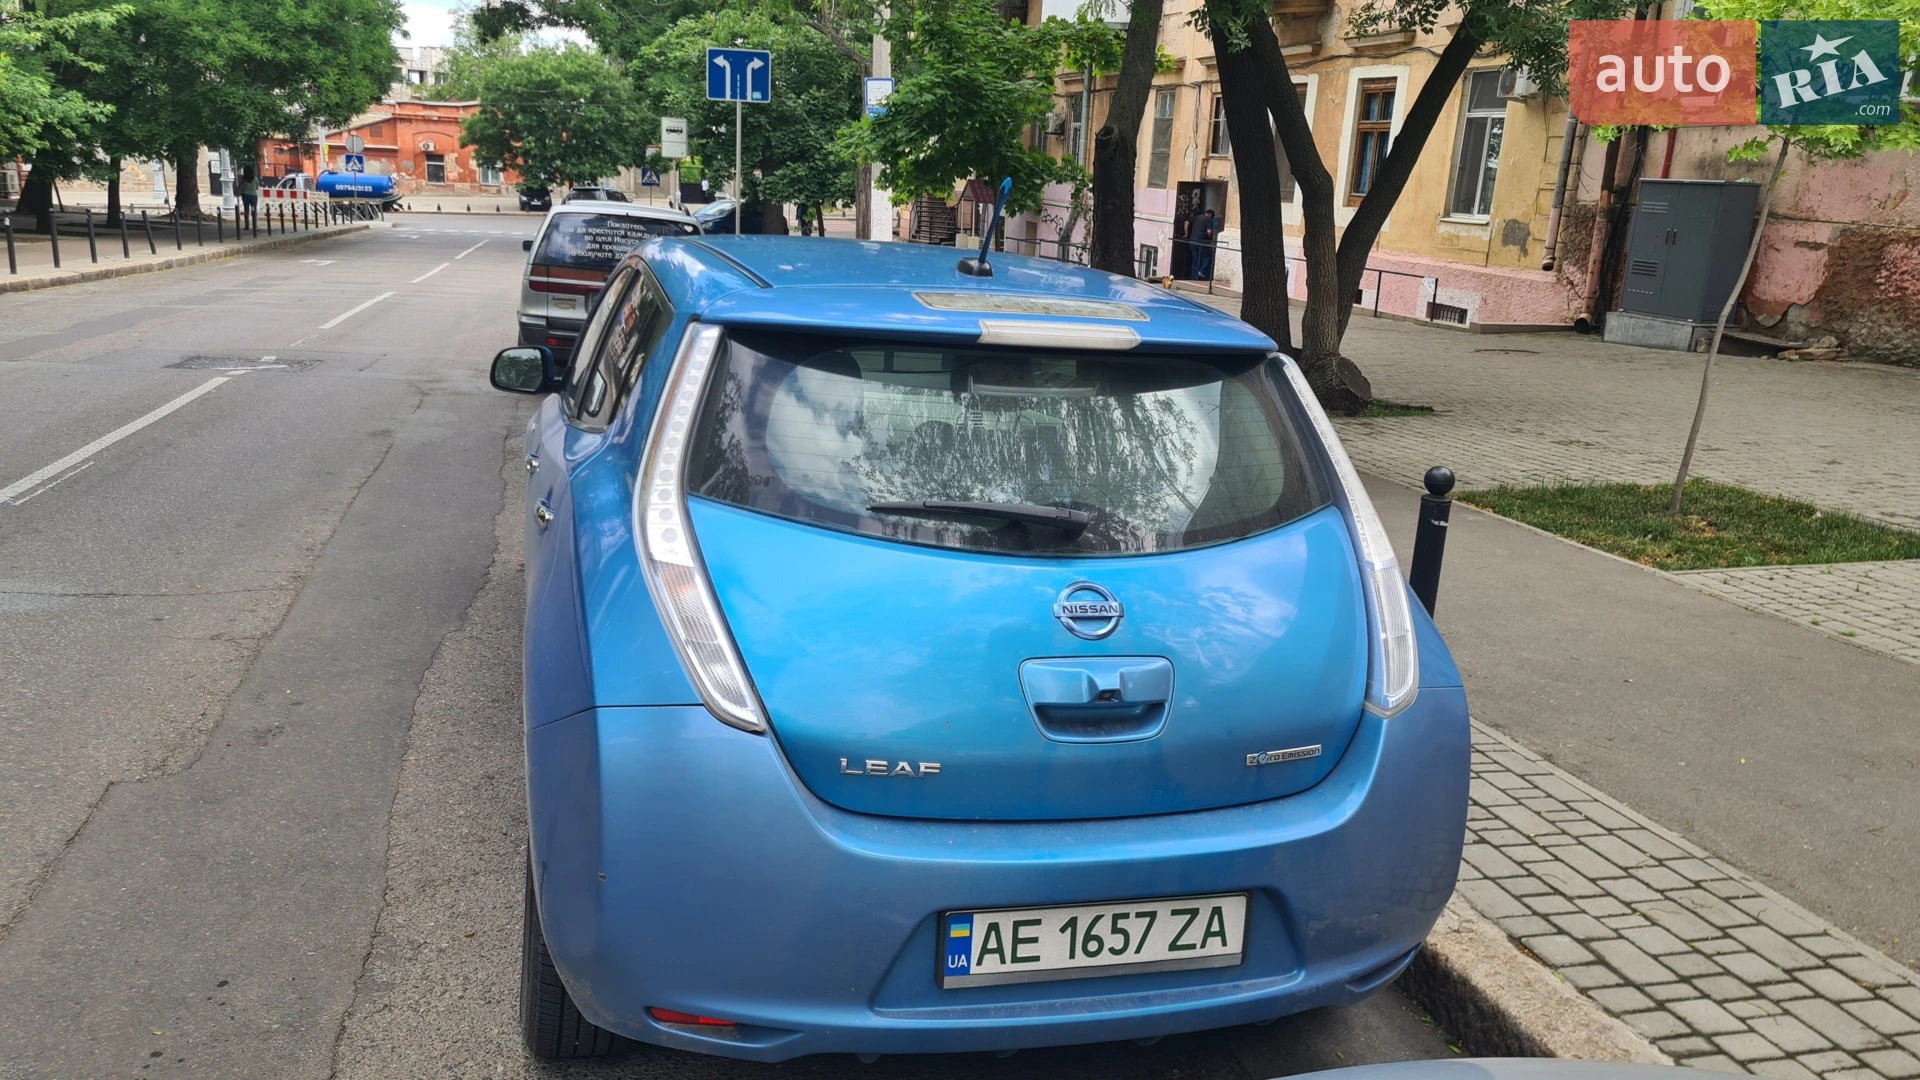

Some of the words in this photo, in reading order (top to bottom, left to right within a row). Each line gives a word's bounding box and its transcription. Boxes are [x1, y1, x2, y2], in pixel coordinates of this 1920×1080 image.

[588, 228, 625, 236] крестится
[1062, 604, 1119, 614] NISSAN
[1281, 748, 1320, 760] Emission
[840, 758, 942, 778] LEAF
[976, 918, 1042, 966] AE
[1059, 911, 1158, 960] 1657
[1167, 906, 1228, 952] ZA
[948, 954, 968, 969] UA
